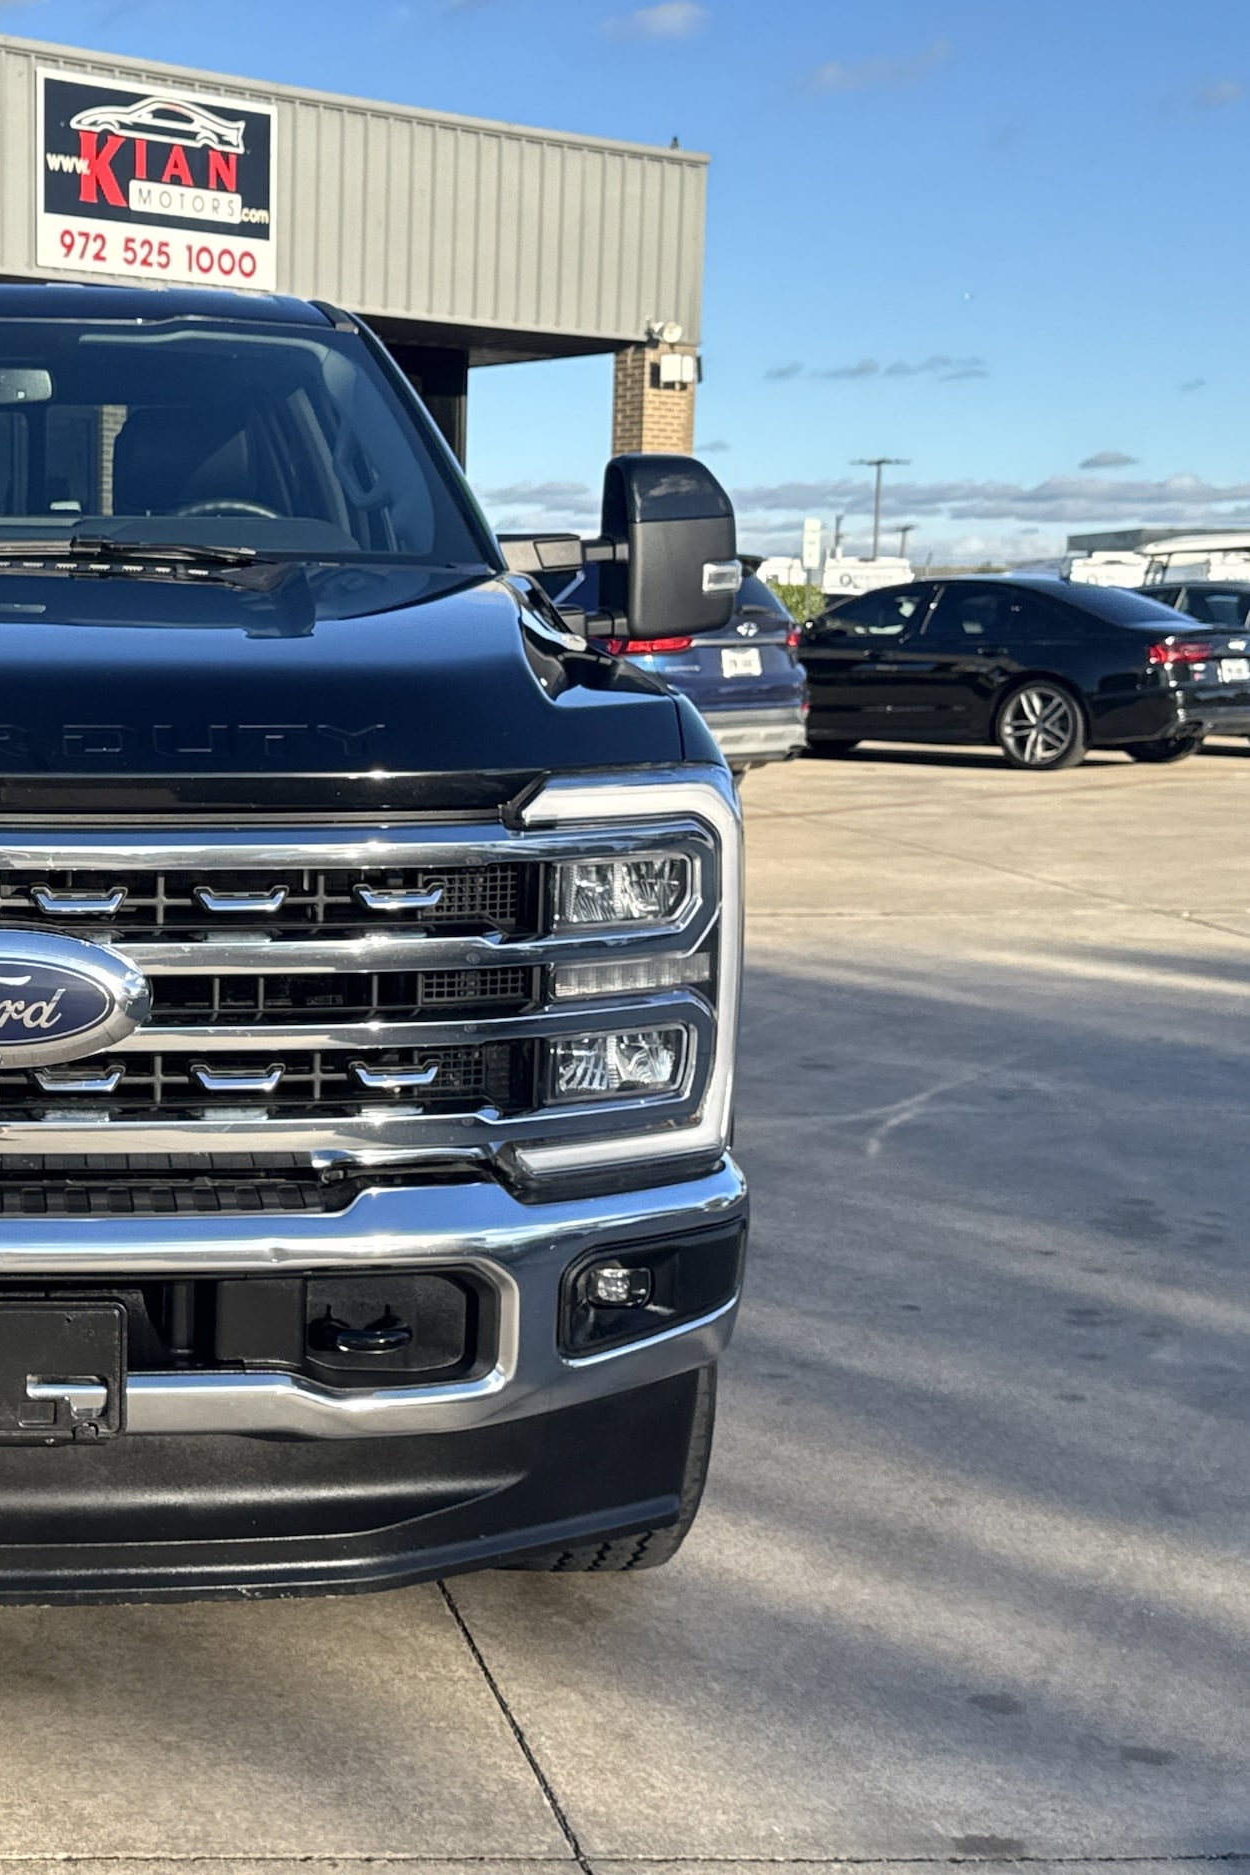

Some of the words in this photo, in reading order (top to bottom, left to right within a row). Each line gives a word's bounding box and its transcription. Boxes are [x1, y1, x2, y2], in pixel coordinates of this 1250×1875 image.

[78, 130, 238, 208] KIAN
[138, 187, 236, 217] MOTORS
[60, 229, 107, 262] 972
[122, 237, 171, 269] 525
[185, 244, 257, 278] 1000
[62, 723, 387, 758] DUTY
